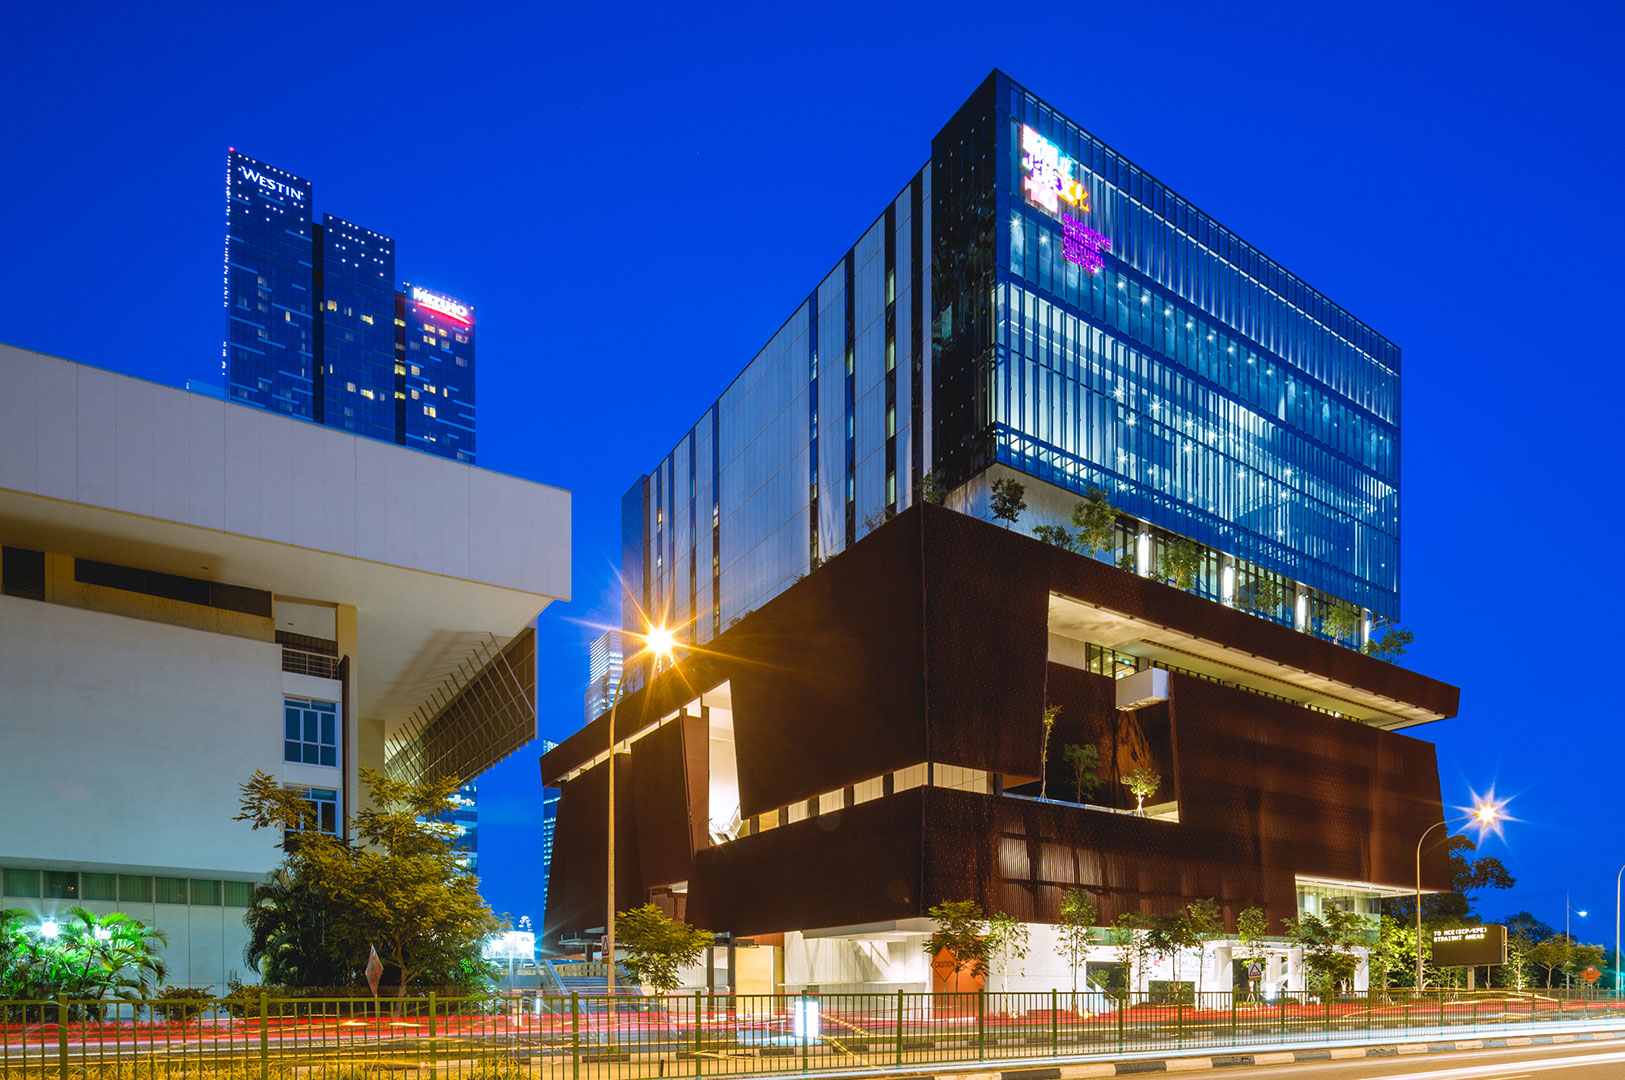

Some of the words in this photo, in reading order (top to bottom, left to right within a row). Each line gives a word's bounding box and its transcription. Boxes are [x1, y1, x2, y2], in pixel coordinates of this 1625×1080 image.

[241, 165, 301, 200] WESTIN
[1063, 213, 1112, 250] SINGAPORE
[1063, 225, 1101, 254] CHINESE
[1063, 236, 1106, 269] CULTURAL
[1063, 248, 1097, 275] CENTRE
[413, 286, 468, 317] MIZUHO
